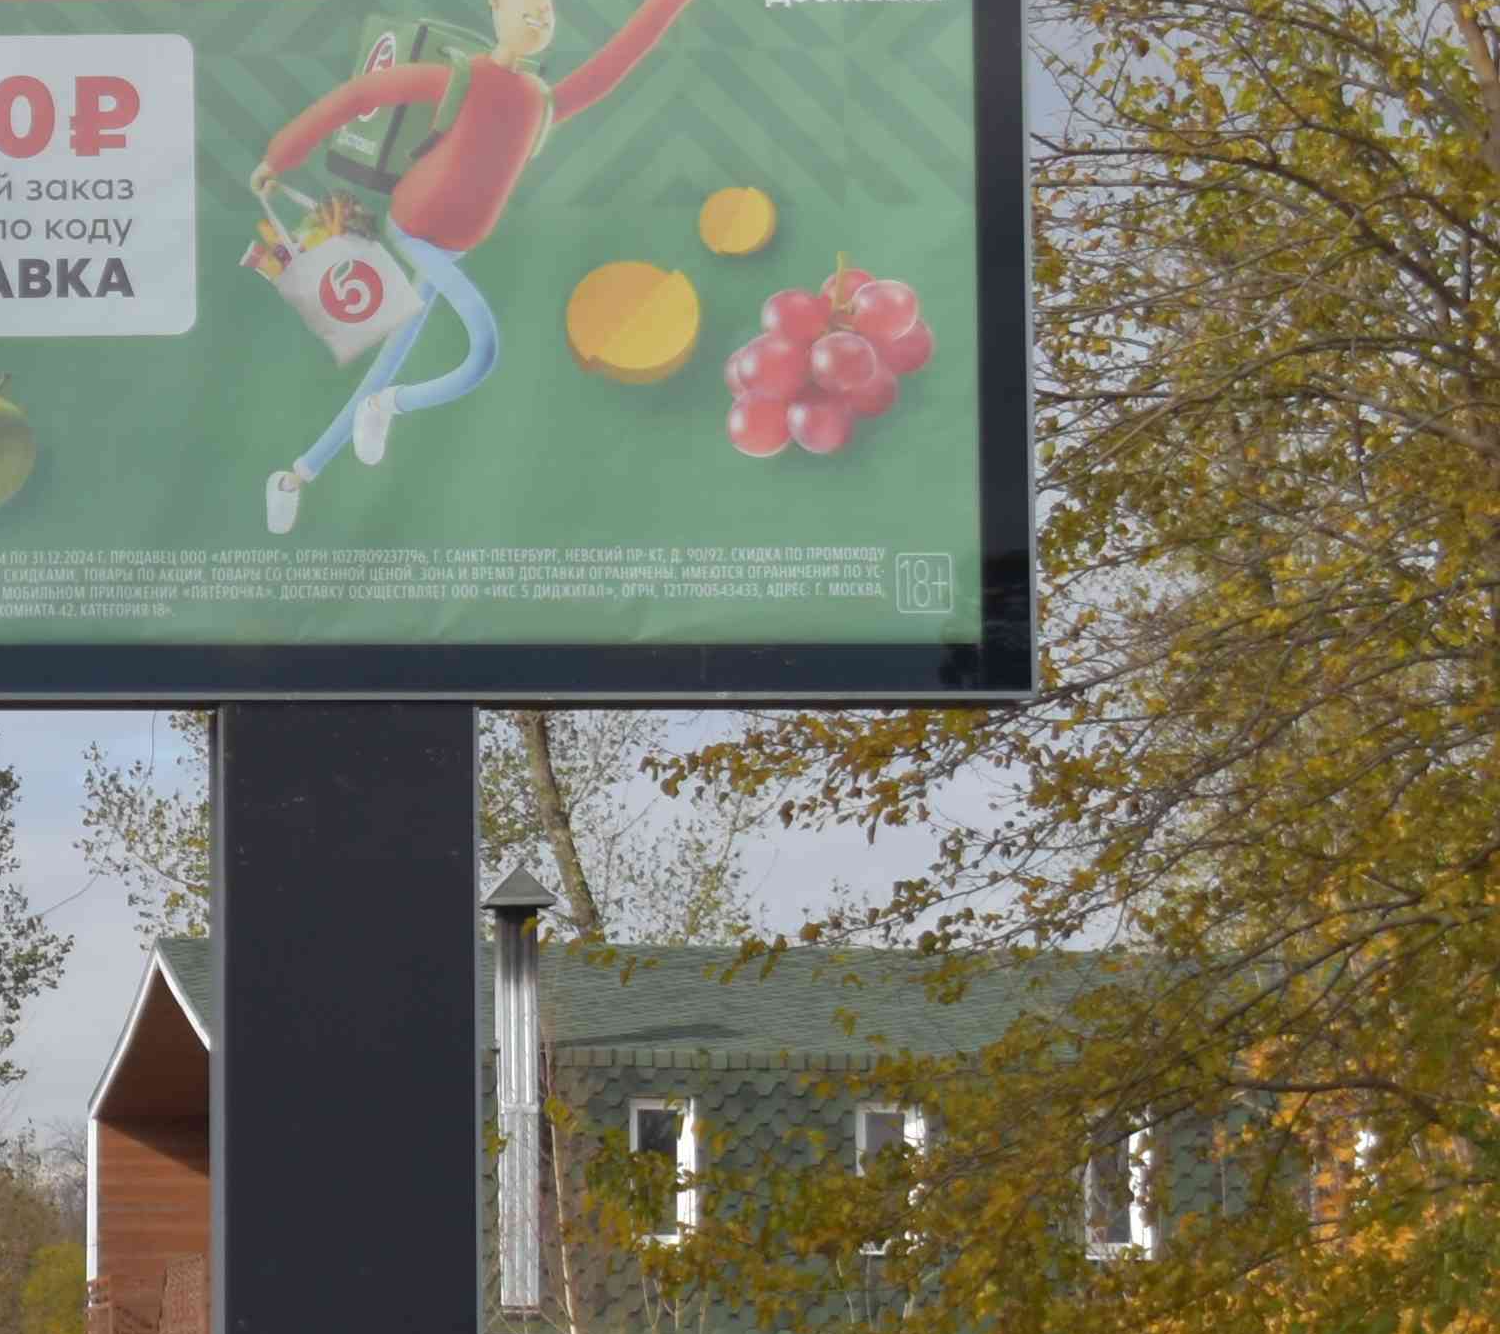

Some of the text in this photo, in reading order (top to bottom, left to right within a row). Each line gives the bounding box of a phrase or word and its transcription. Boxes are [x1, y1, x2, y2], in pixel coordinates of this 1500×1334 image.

[26, 178, 135, 201] заказ
[45, 217, 133, 247] коду
[110, 550, 176, 566] ПРОДАВЕЦ
[180, 550, 206, 564] ООО
[565, 545, 622, 562] НЕВСКИЙ
[731, 548, 780, 564] СКИДКА
[899, 560, 948, 608] 18+
